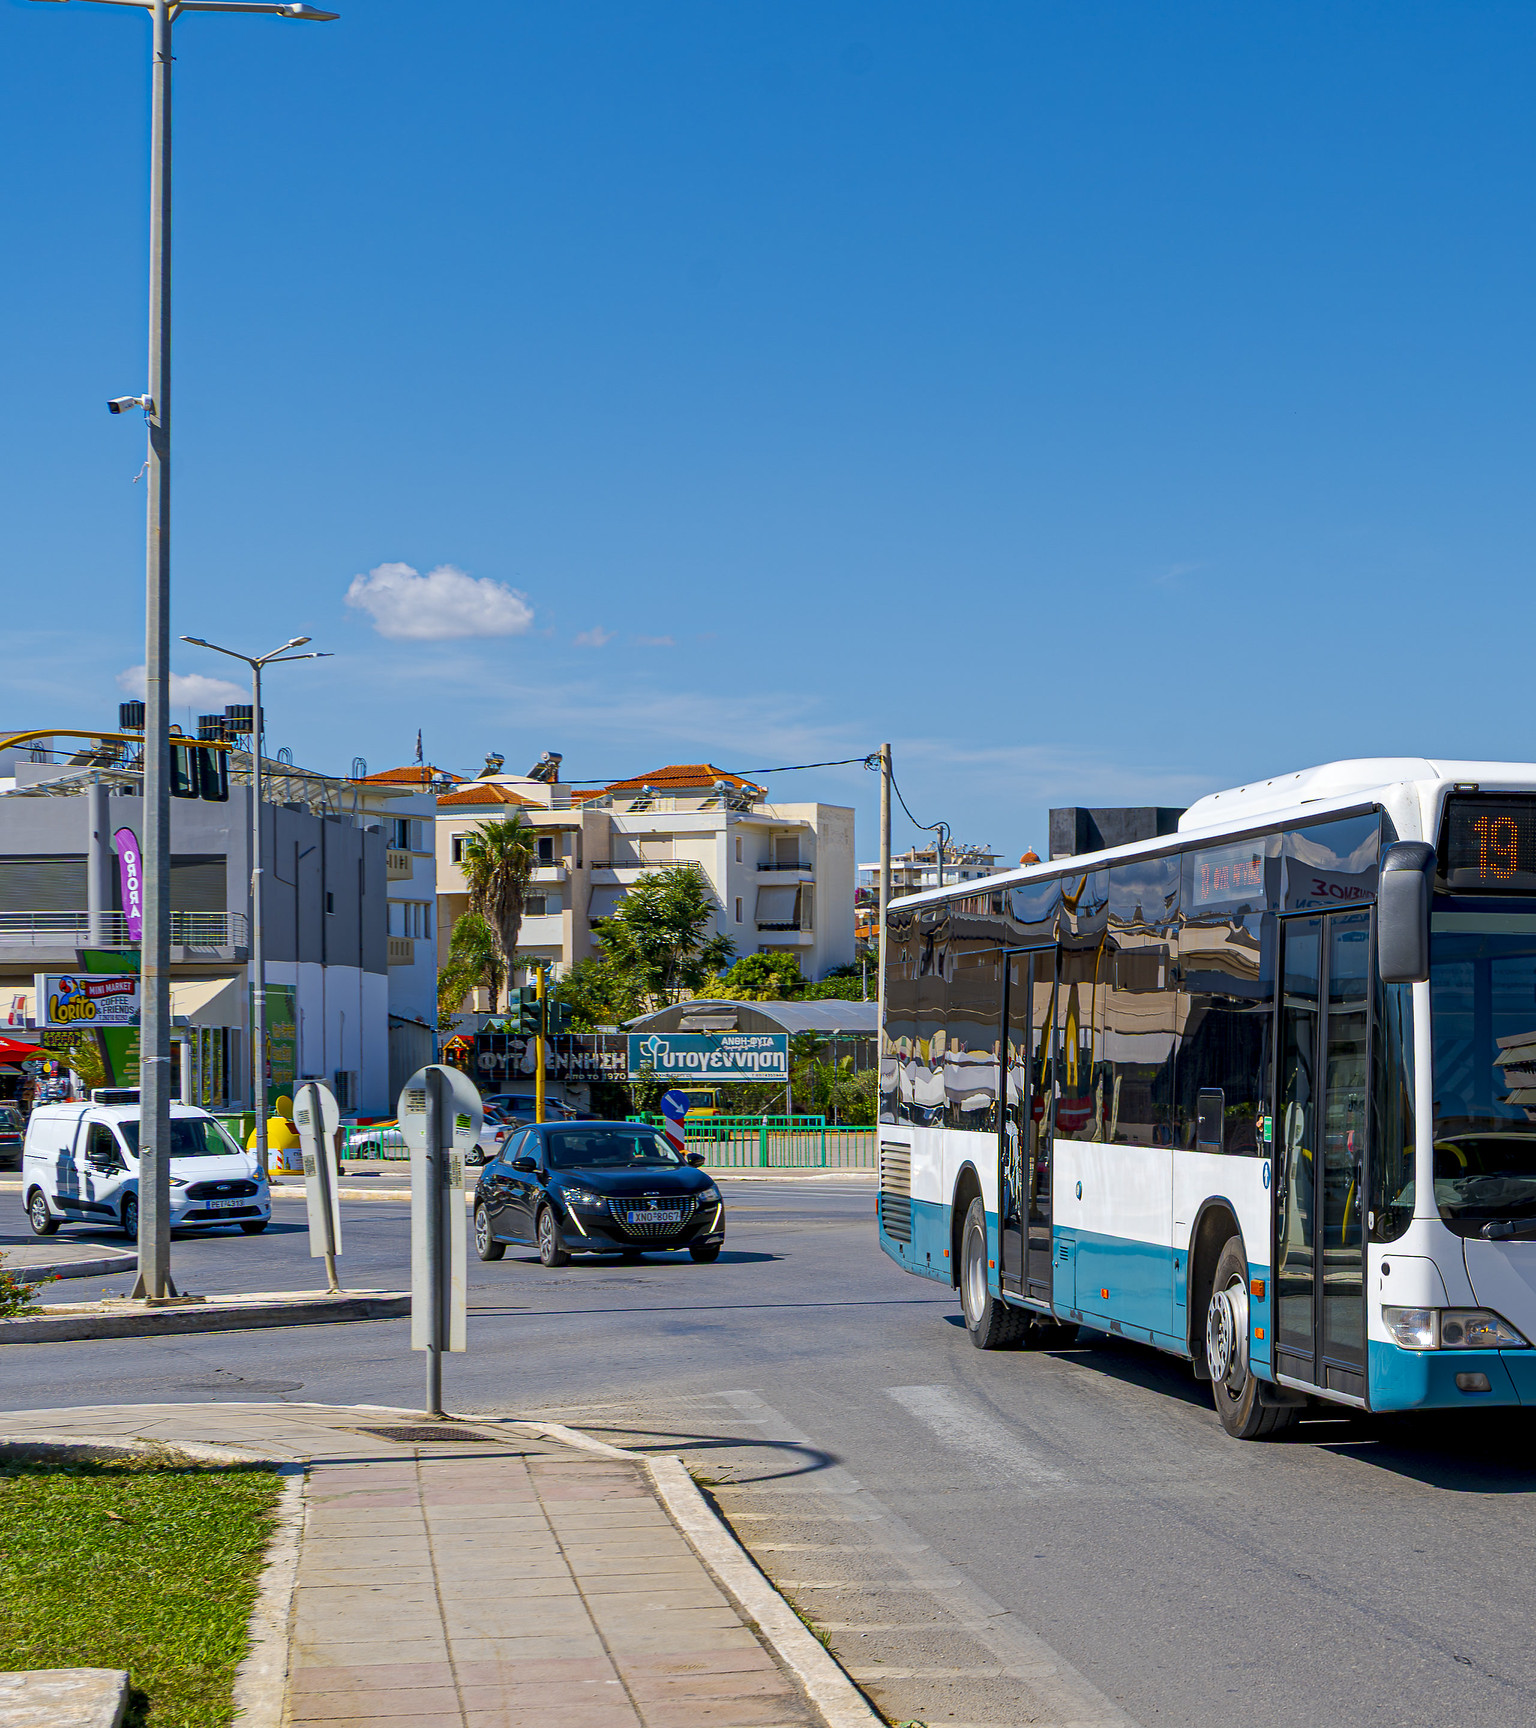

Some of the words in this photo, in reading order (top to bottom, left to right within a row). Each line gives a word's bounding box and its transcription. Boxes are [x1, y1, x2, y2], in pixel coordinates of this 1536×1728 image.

[1474, 816, 1518, 879] 19
[89, 985, 105, 995] MINI
[106, 981, 131, 993] MARKET
[100, 996, 129, 1006] COFFEE
[103, 1005, 135, 1014] FRIENDS
[47, 1035, 75, 1043] OPEN
[721, 1037, 775, 1046] ΑΝΘΗ-ΦΥΤΑ
[604, 1072, 627, 1080] 1970
